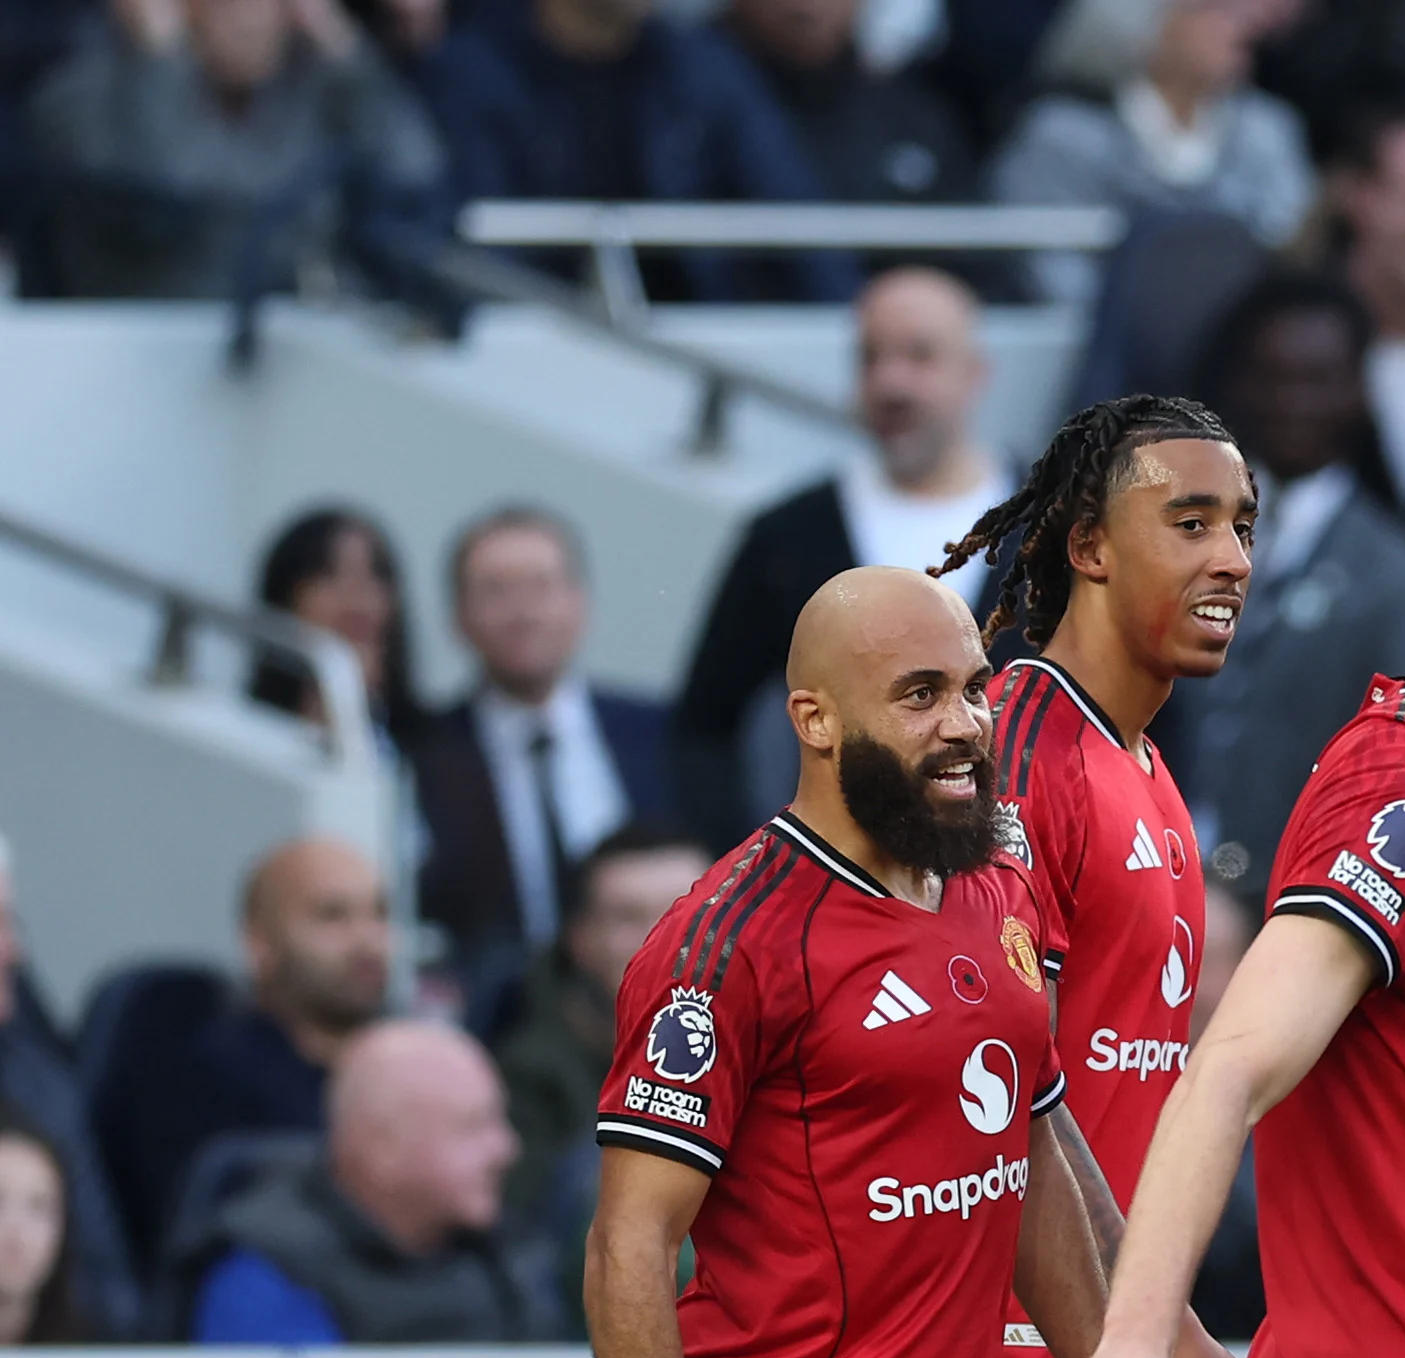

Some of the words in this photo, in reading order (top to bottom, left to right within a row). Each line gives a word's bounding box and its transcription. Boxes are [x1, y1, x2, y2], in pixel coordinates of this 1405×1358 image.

[1328, 866, 1356, 885] for
[1352, 879, 1400, 925] racism
[1338, 850, 1363, 874] No
[1361, 868, 1403, 909] room
[625, 1091, 648, 1111] for
[648, 1100, 706, 1127] racism
[630, 1076, 652, 1099] No
[654, 1085, 702, 1111] room
